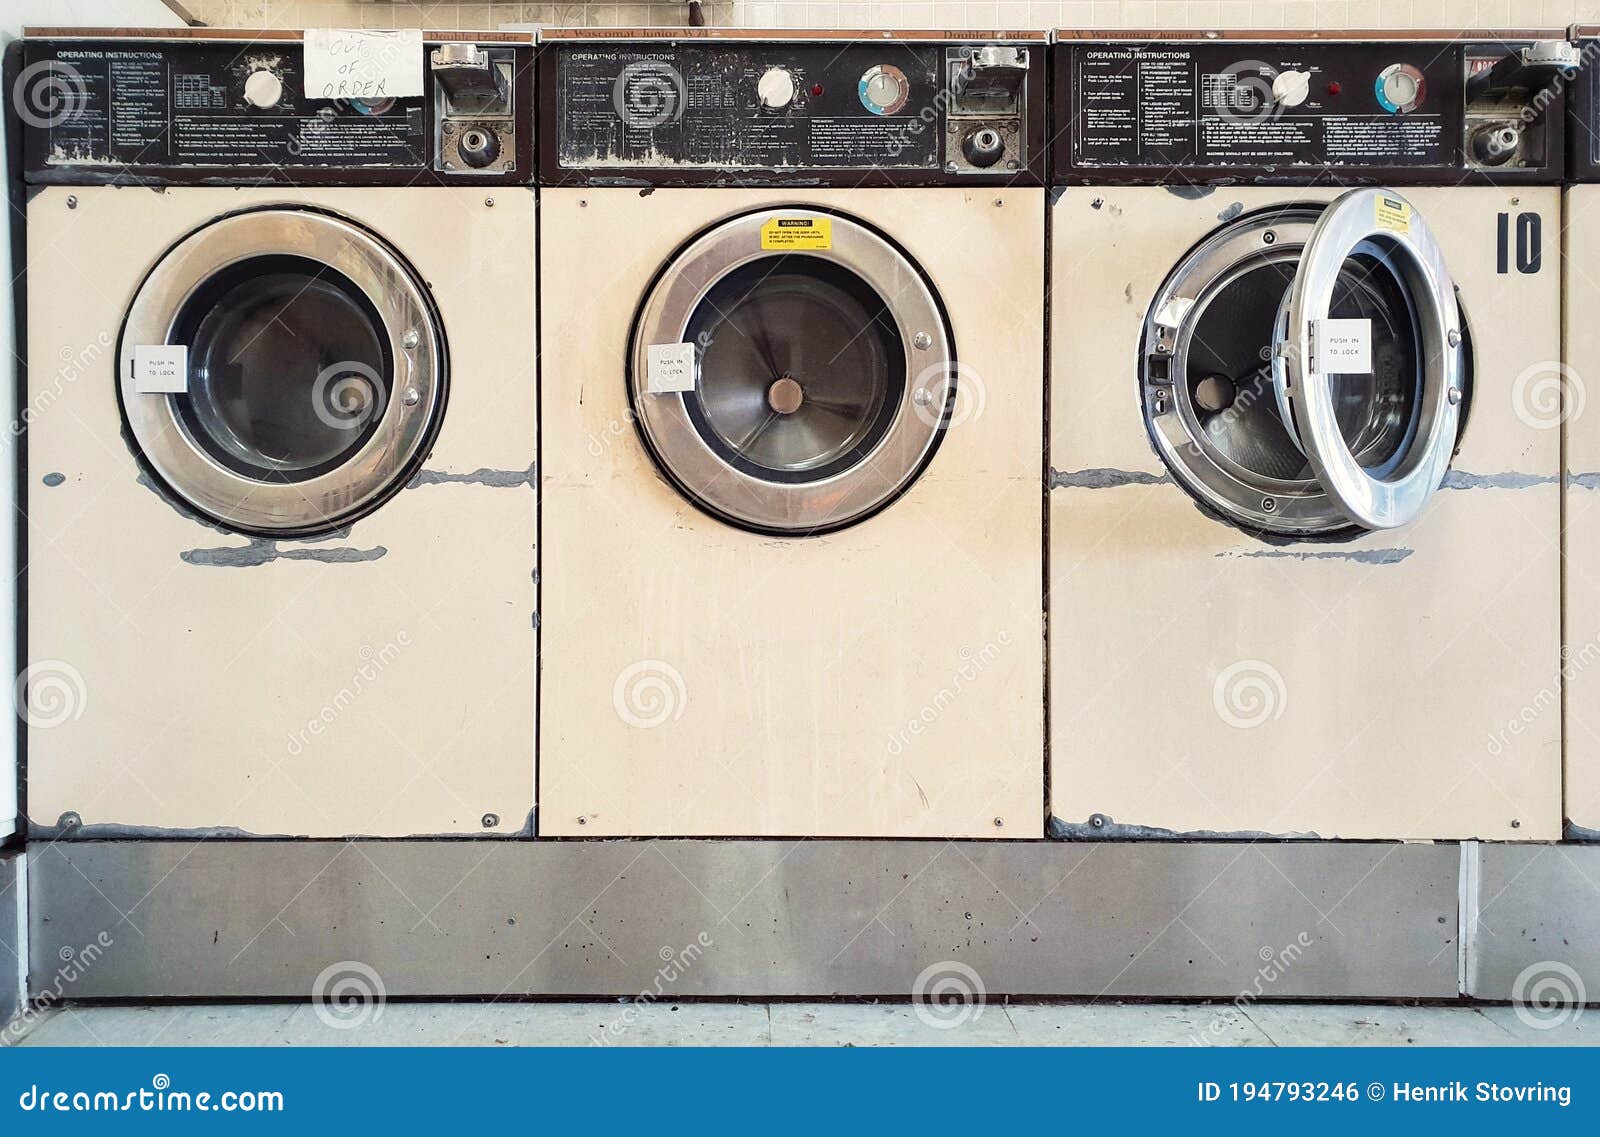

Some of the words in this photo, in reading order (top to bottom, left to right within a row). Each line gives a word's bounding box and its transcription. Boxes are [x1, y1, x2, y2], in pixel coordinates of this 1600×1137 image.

[574, 29, 635, 38] Wascomat
[642, 29, 677, 38] Junior
[944, 30, 986, 39] Double
[991, 30, 1033, 39] Lader
[57, 51, 103, 59] OPERATING
[105, 51, 163, 59] INSTRUCTIONS
[322, 78, 387, 98] ORDER
[1497, 212, 1541, 274] 10
